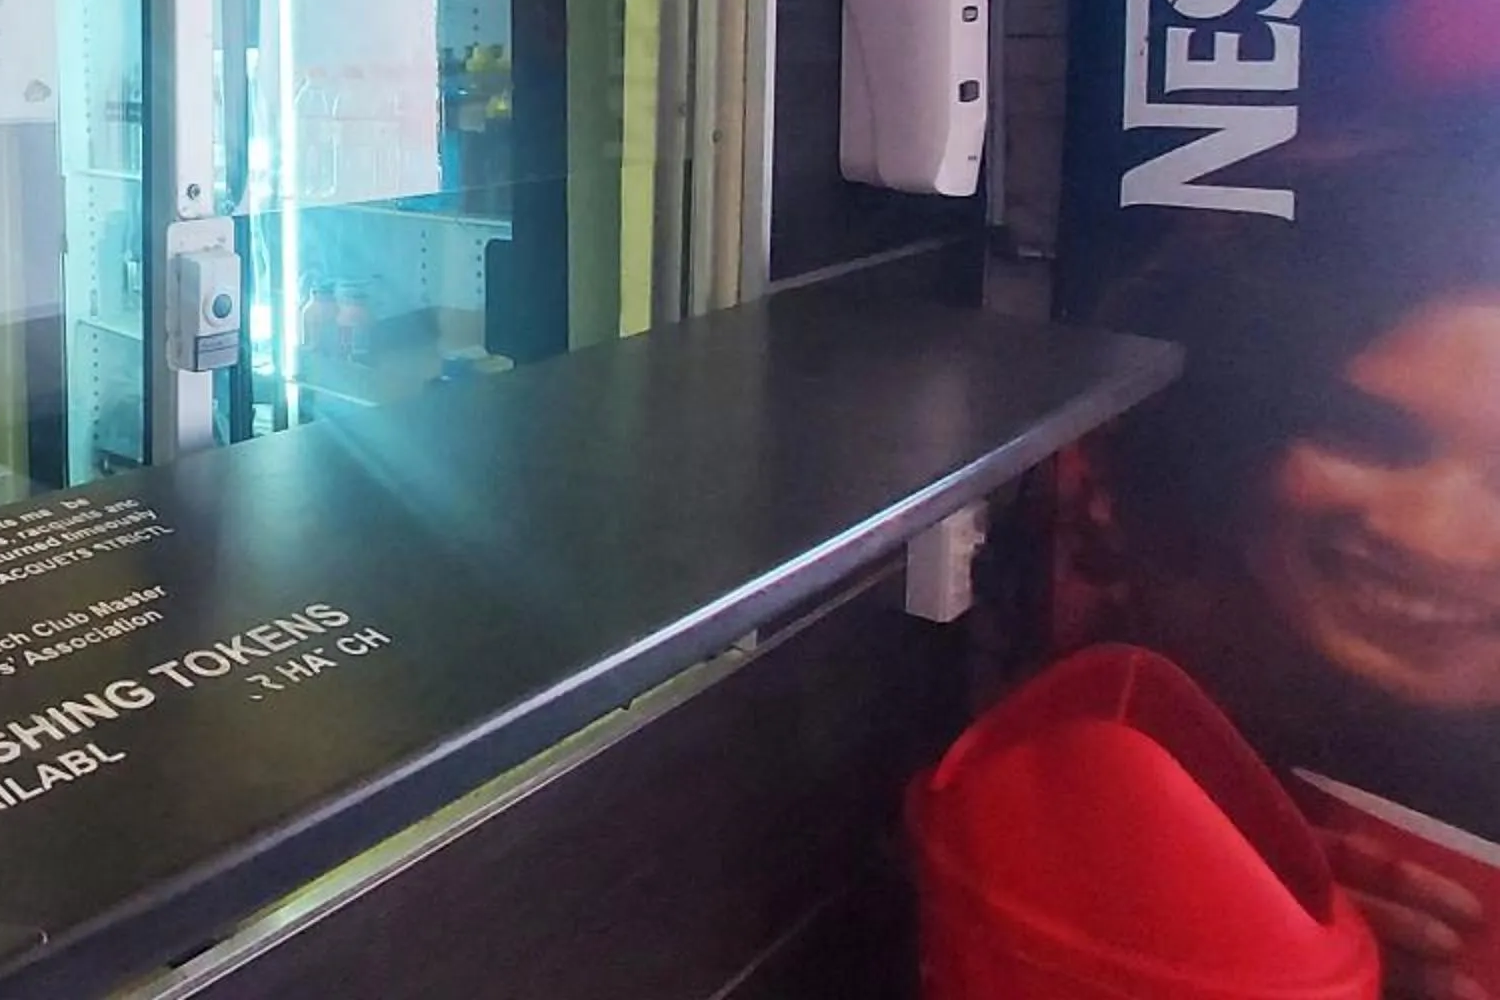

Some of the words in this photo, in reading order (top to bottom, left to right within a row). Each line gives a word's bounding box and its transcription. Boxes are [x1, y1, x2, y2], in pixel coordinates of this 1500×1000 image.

[18, 510, 103, 540] racquets
[20, 507, 53, 524] ma
[60, 497, 90, 509] be
[62, 509, 158, 541] timeously
[23, 608, 165, 666] Association
[31, 610, 90, 637] Club
[88, 584, 168, 619] Master
[148, 602, 350, 688] TOKENS
[275, 627, 391, 683] HACH
